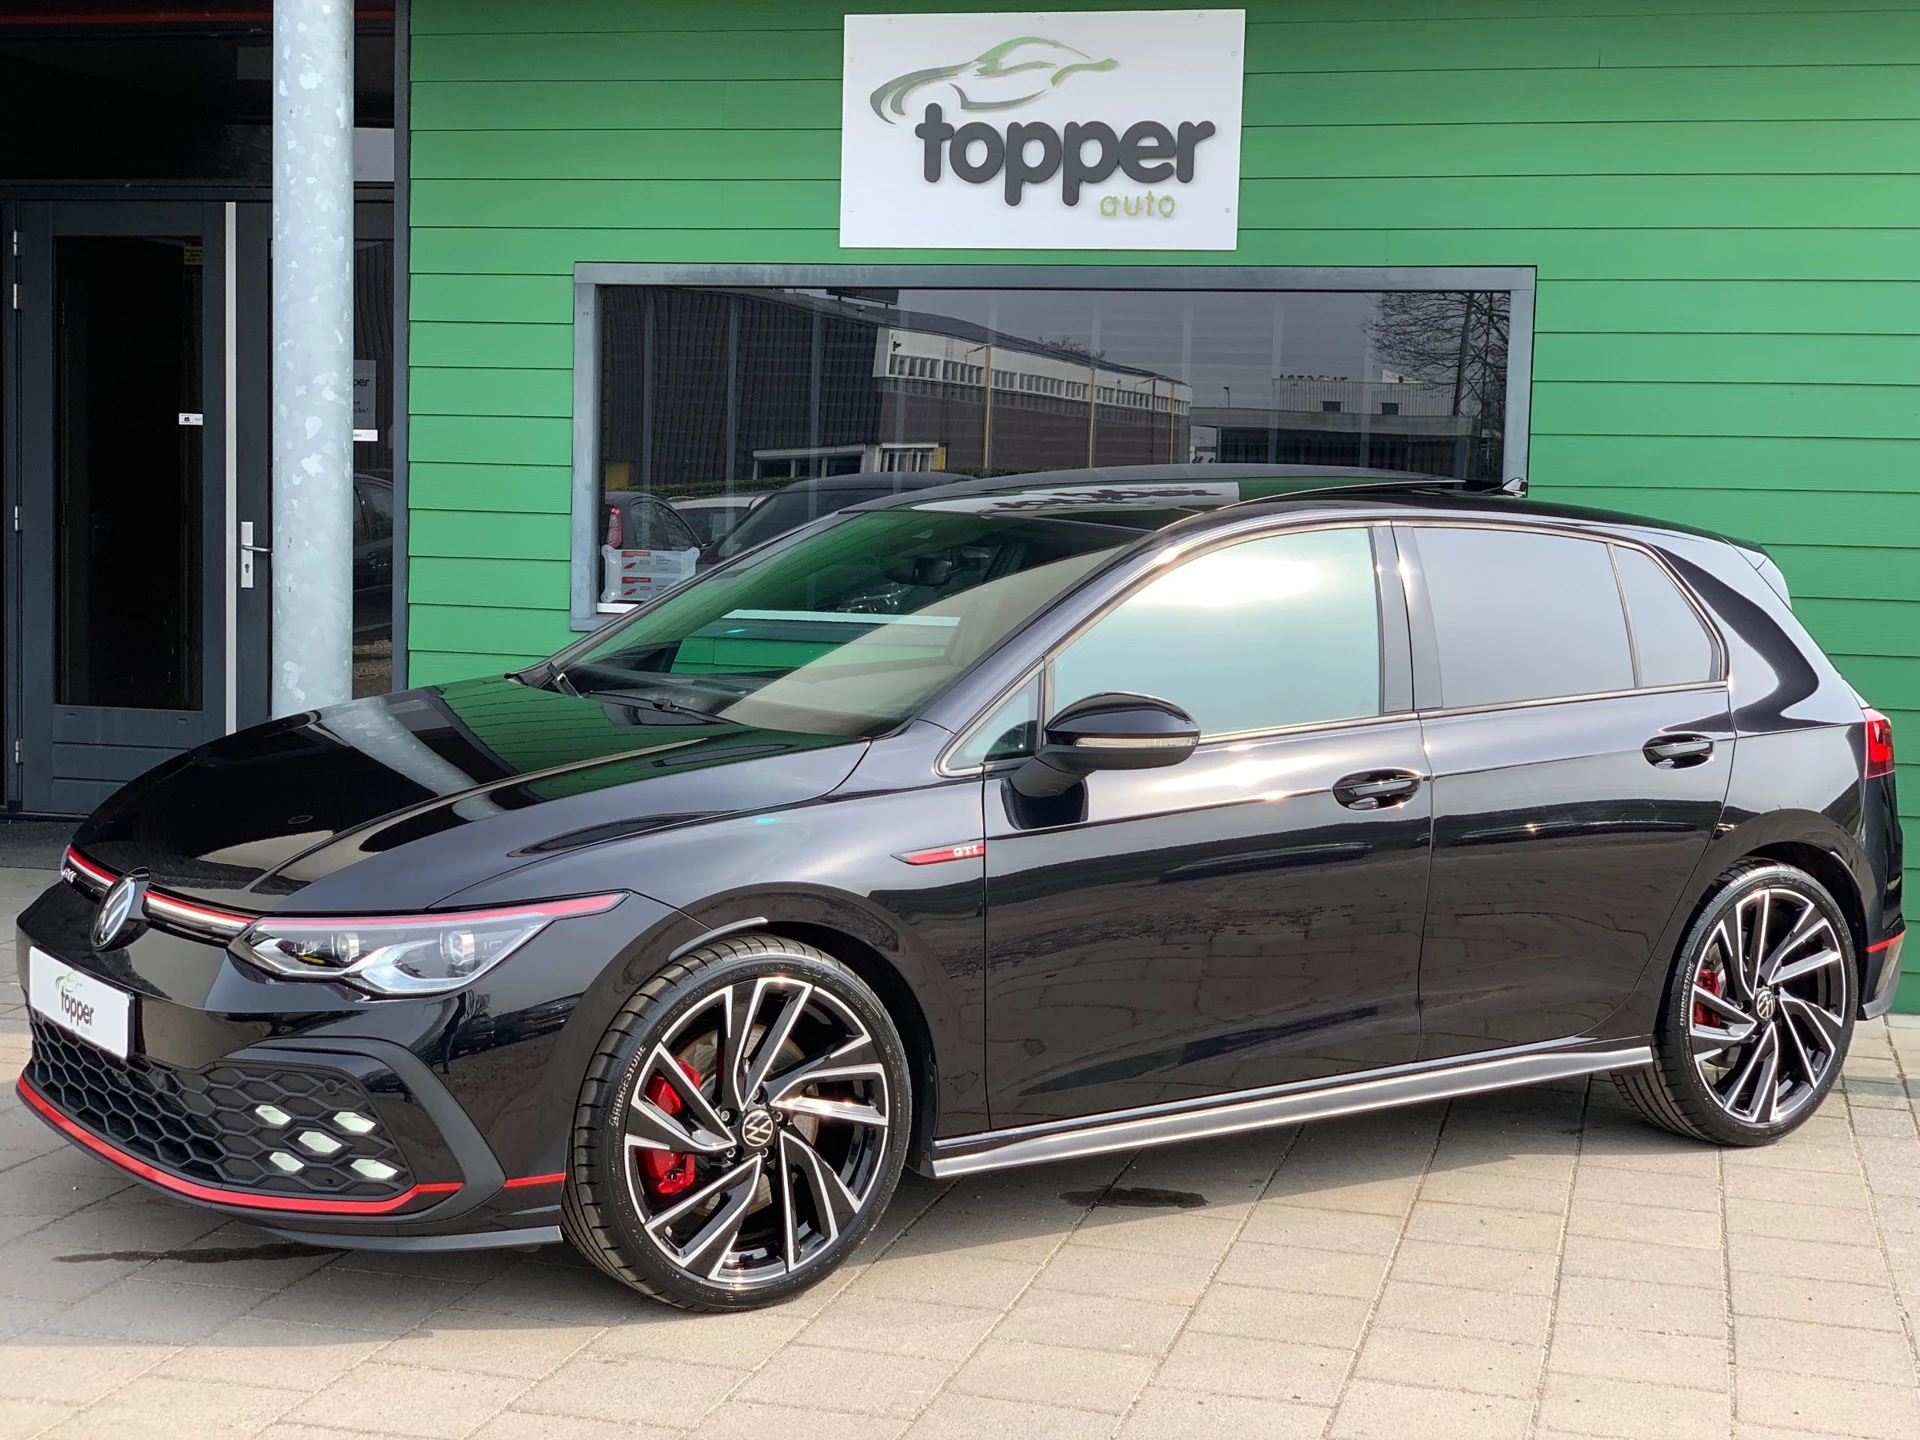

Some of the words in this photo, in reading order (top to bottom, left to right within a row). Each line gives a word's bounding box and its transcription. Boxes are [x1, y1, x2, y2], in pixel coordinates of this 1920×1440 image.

[915, 103, 1215, 206] topper
[1100, 190, 1176, 217] auto
[953, 845, 979, 857] GTI
[60, 986, 95, 1027] topper
[609, 1045, 646, 1126] BRIDGESTONE
